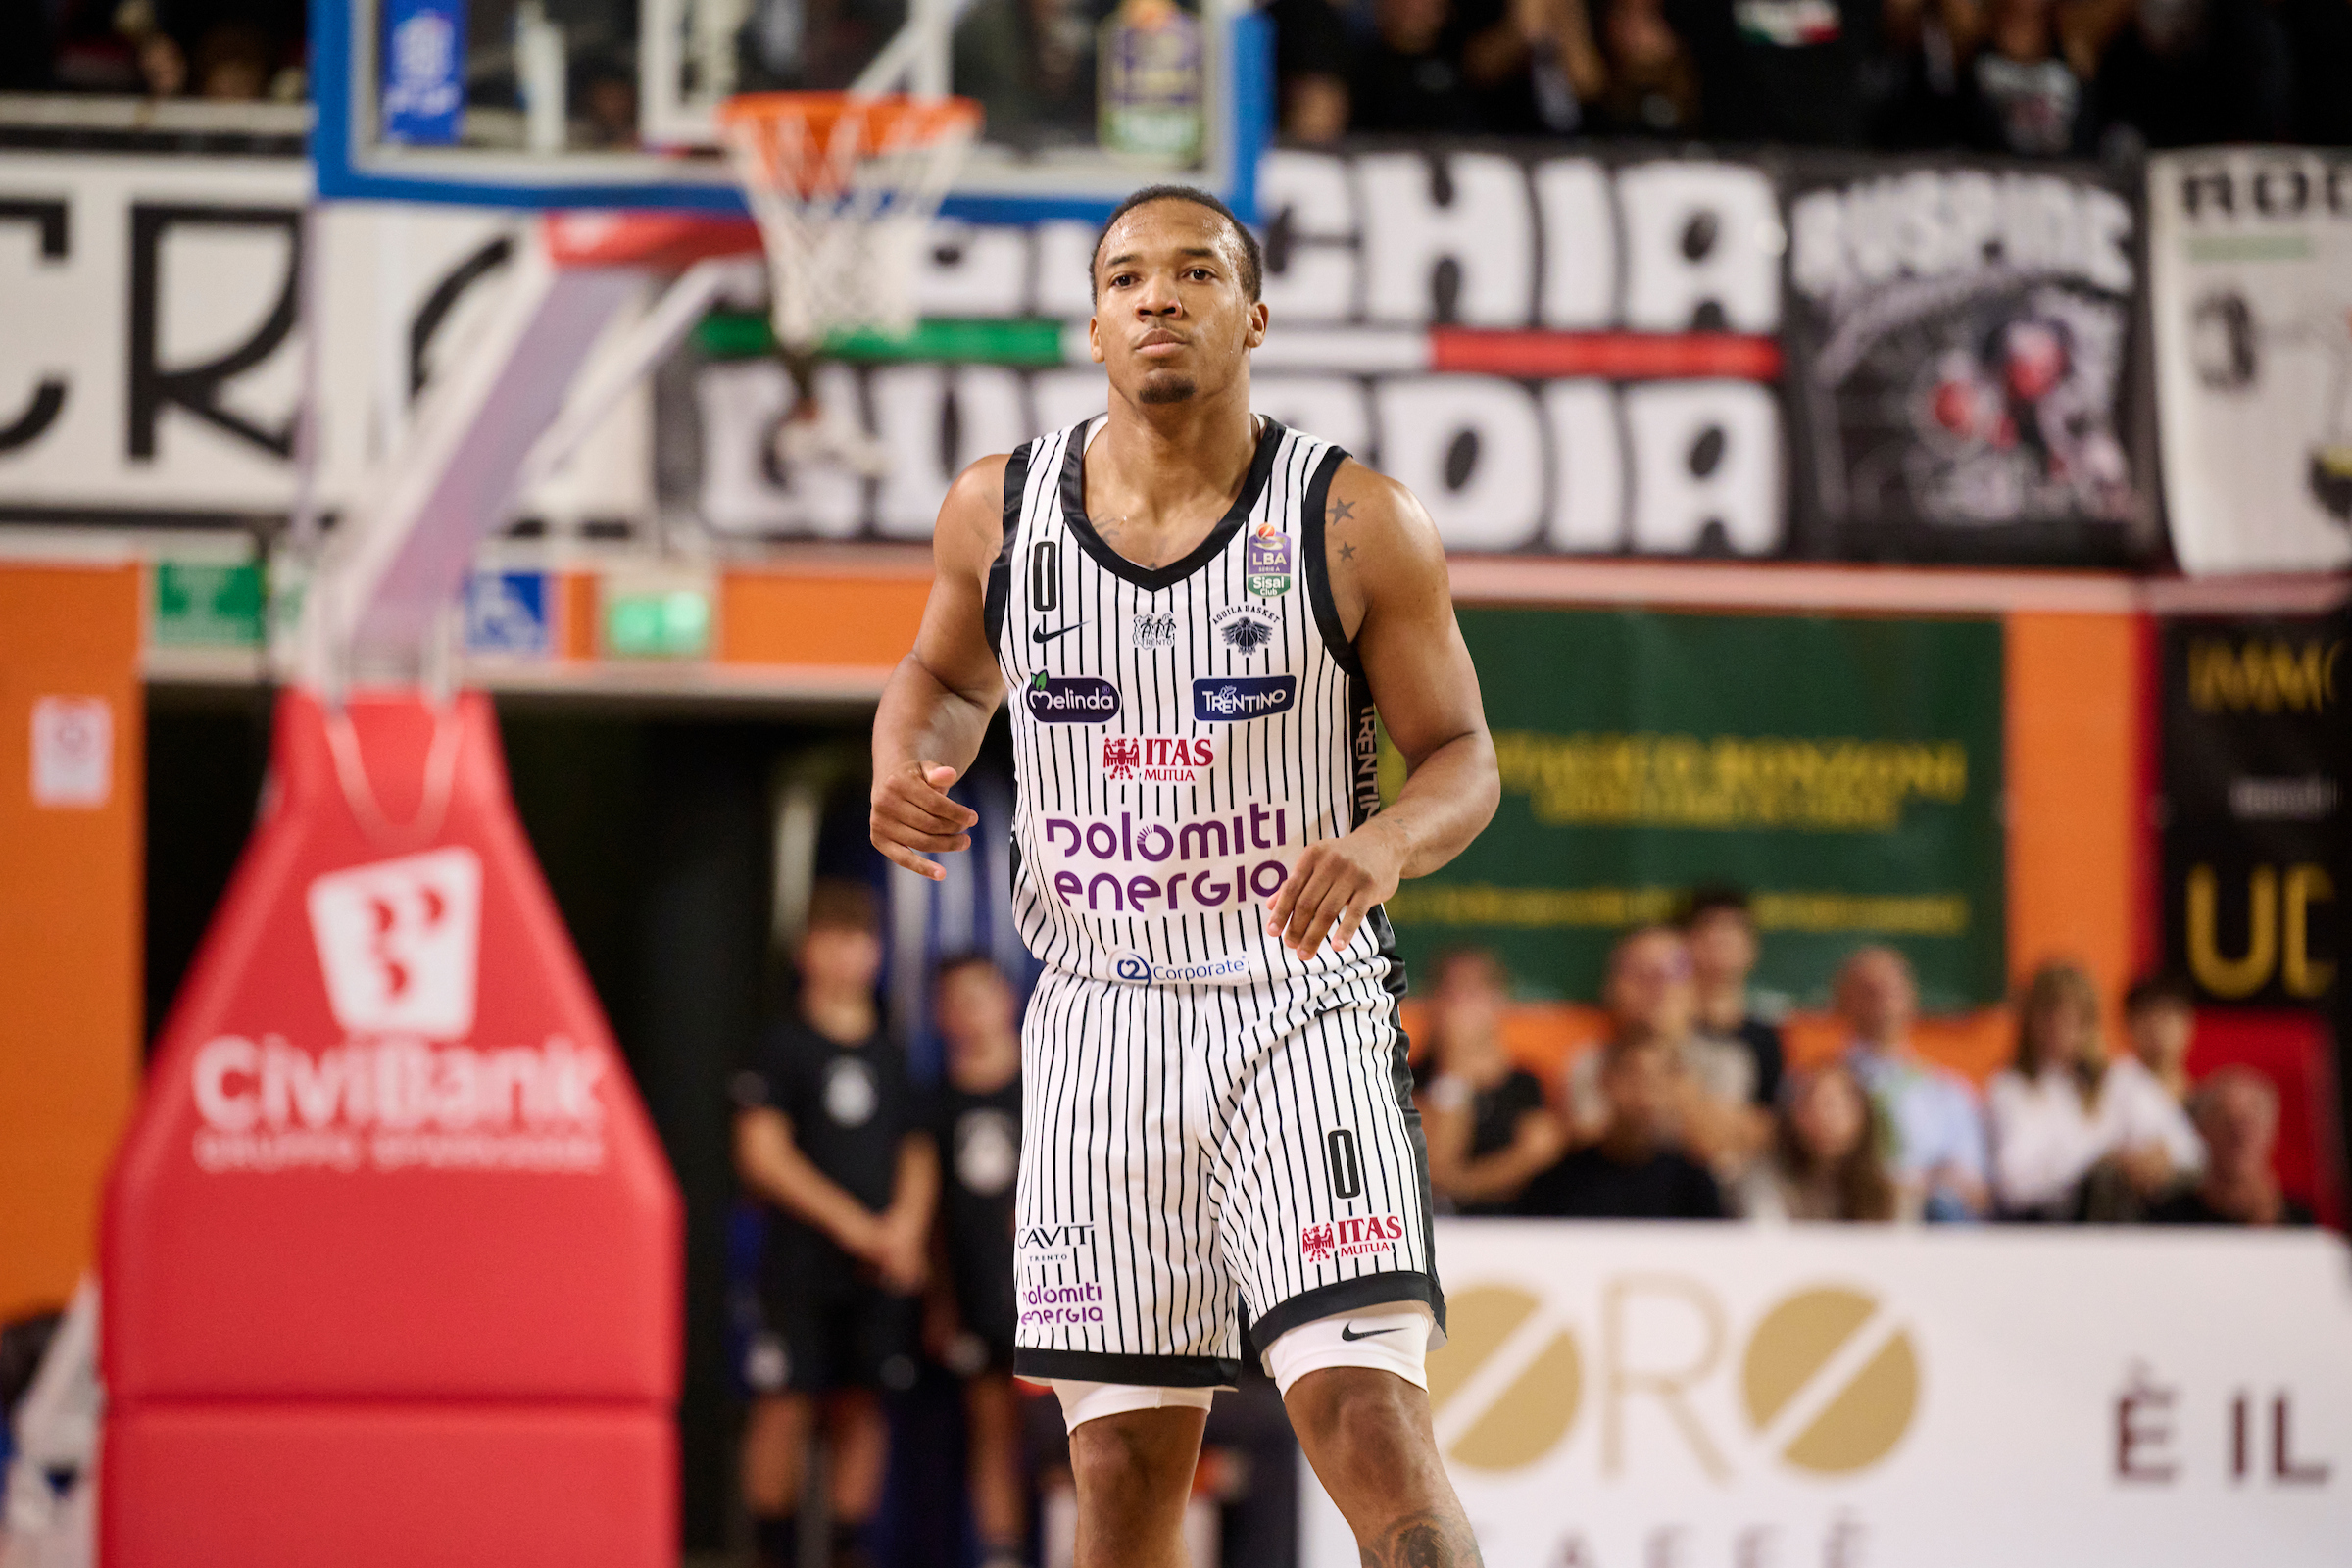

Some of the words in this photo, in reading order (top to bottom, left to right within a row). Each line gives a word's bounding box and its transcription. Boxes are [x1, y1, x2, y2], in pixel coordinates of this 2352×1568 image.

[1252, 552, 1287, 565] LBA
[1033, 541, 1056, 612] 0
[1253, 576, 1285, 589] Sisal
[1212, 605, 1243, 625] AQUILA
[1245, 605, 1281, 623] BASKET
[1029, 687, 1114, 710] Melinda
[1144, 739, 1214, 766] ITAS
[1356, 706, 1381, 821] TRENTIN
[1144, 769, 1197, 782] MUTUA
[1153, 958, 1245, 982] Corporate
[1327, 1129, 1361, 1200] 0
[1018, 1224, 1094, 1250] CAVIT
[1337, 1215, 1402, 1245] ITAS
[1341, 1242, 1390, 1257] MUTUA
